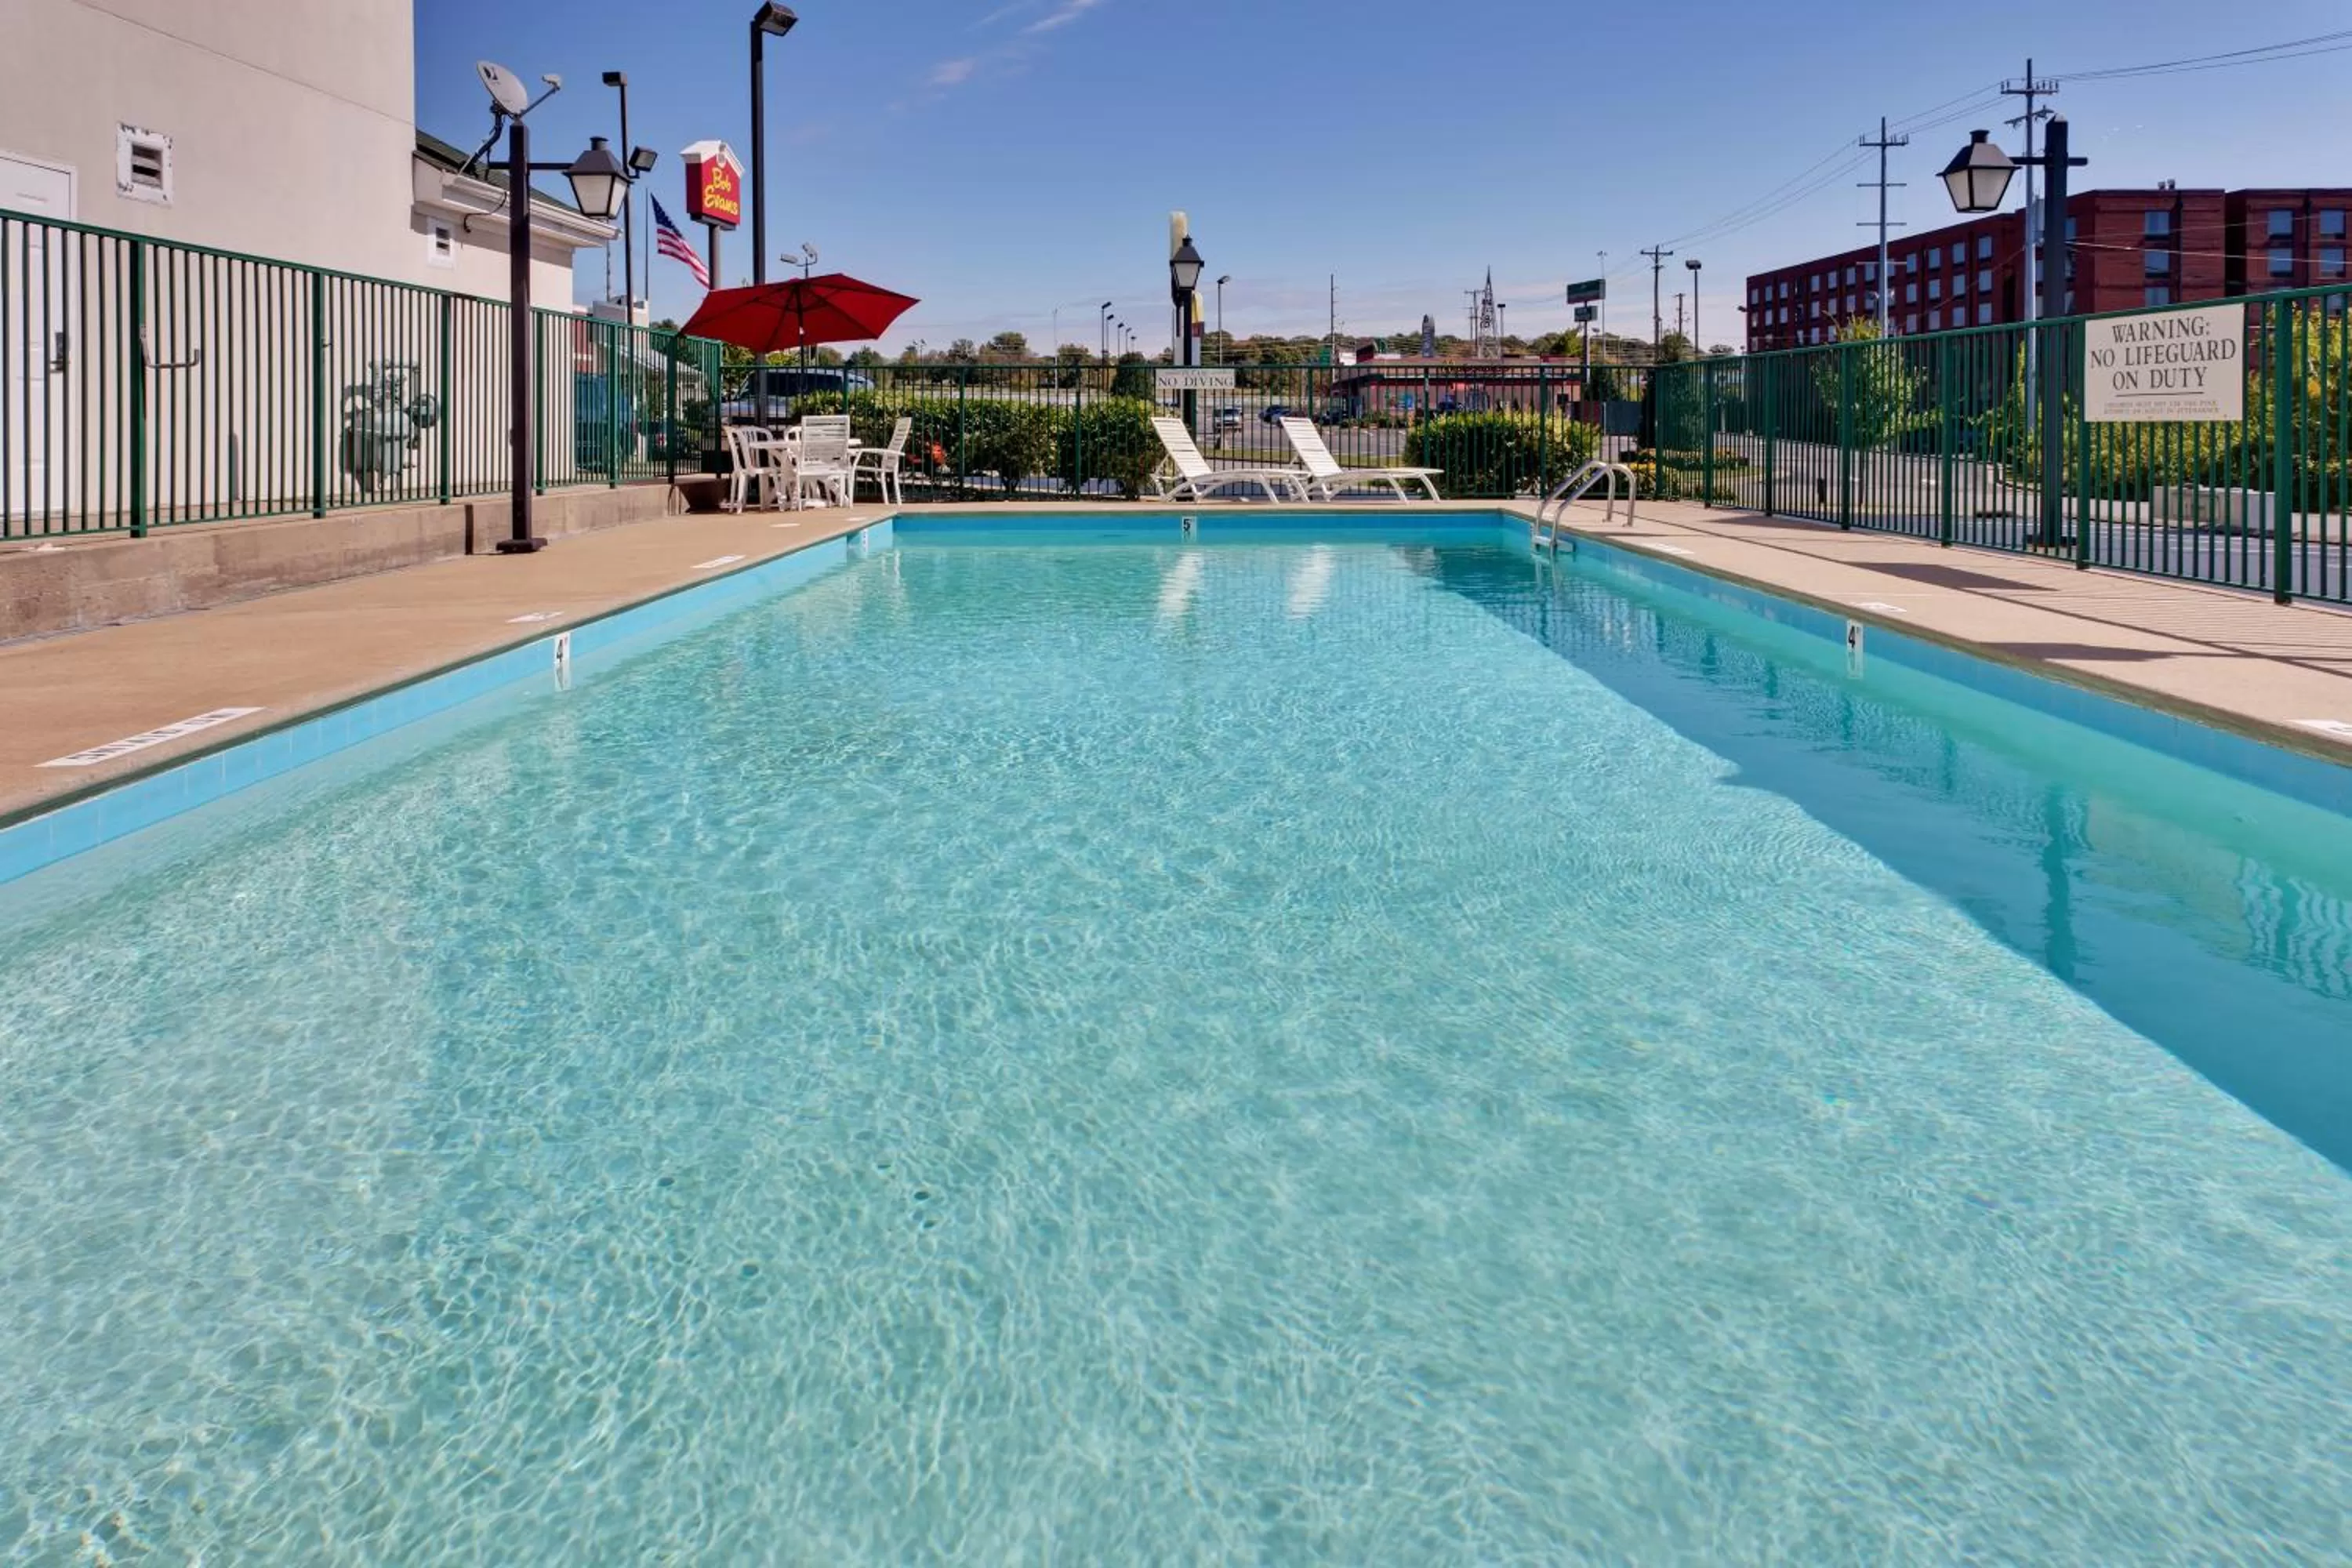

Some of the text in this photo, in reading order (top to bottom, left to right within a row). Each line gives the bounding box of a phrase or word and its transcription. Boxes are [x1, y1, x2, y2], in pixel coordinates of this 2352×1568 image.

[712, 167, 731, 192] Bob
[704, 184, 738, 216] Evans
[2112, 317, 2210, 343] WARNING:
[2091, 339, 2236, 368] NO LIFEGUARD
[1159, 376, 1234, 387] NO DIVING
[2113, 367, 2208, 390] ON DUTY
